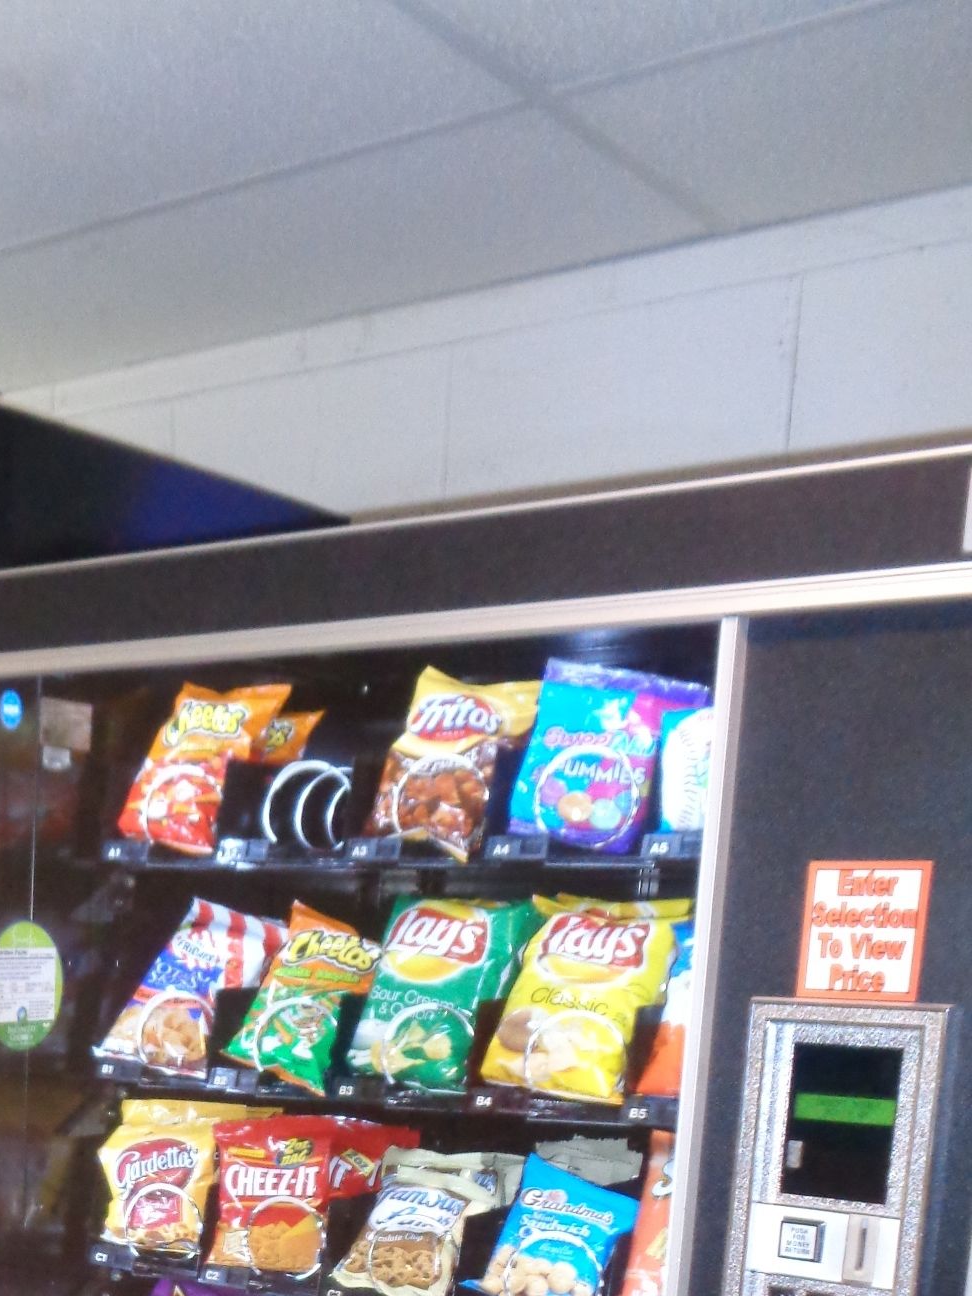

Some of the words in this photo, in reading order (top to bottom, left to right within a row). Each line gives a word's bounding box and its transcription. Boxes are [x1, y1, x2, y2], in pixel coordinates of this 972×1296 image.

[409, 694, 501, 735] Fritos
[164, 702, 246, 746] Cheetos
[107, 848, 121, 858] A1
[351, 845, 368, 857] A3
[492, 844, 510, 856] A4
[649, 842, 669, 855] A5
[837, 868, 899, 896] Enter
[812, 901, 917, 928] Selection
[289, 930, 373, 971] Cheetos
[818, 932, 842, 959] To
[850, 933, 906, 960] View
[829, 963, 885, 991] Price
[370, 984, 402, 1001] Sour
[530, 986, 610, 1016] Classic
[379, 1003, 387, 1015] &
[338, 1085, 355, 1096] B3
[475, 1095, 493, 1107] B4
[629, 1107, 647, 1119] B5
[225, 1164, 320, 1197] CHEEZ-IT
[522, 1188, 614, 1224] Grandma's
[520, 1214, 590, 1238] Sandwich
[792, 1233, 806, 1241] FOR
[95, 1252, 108, 1262] C1
[206, 1271, 219, 1281] C2
